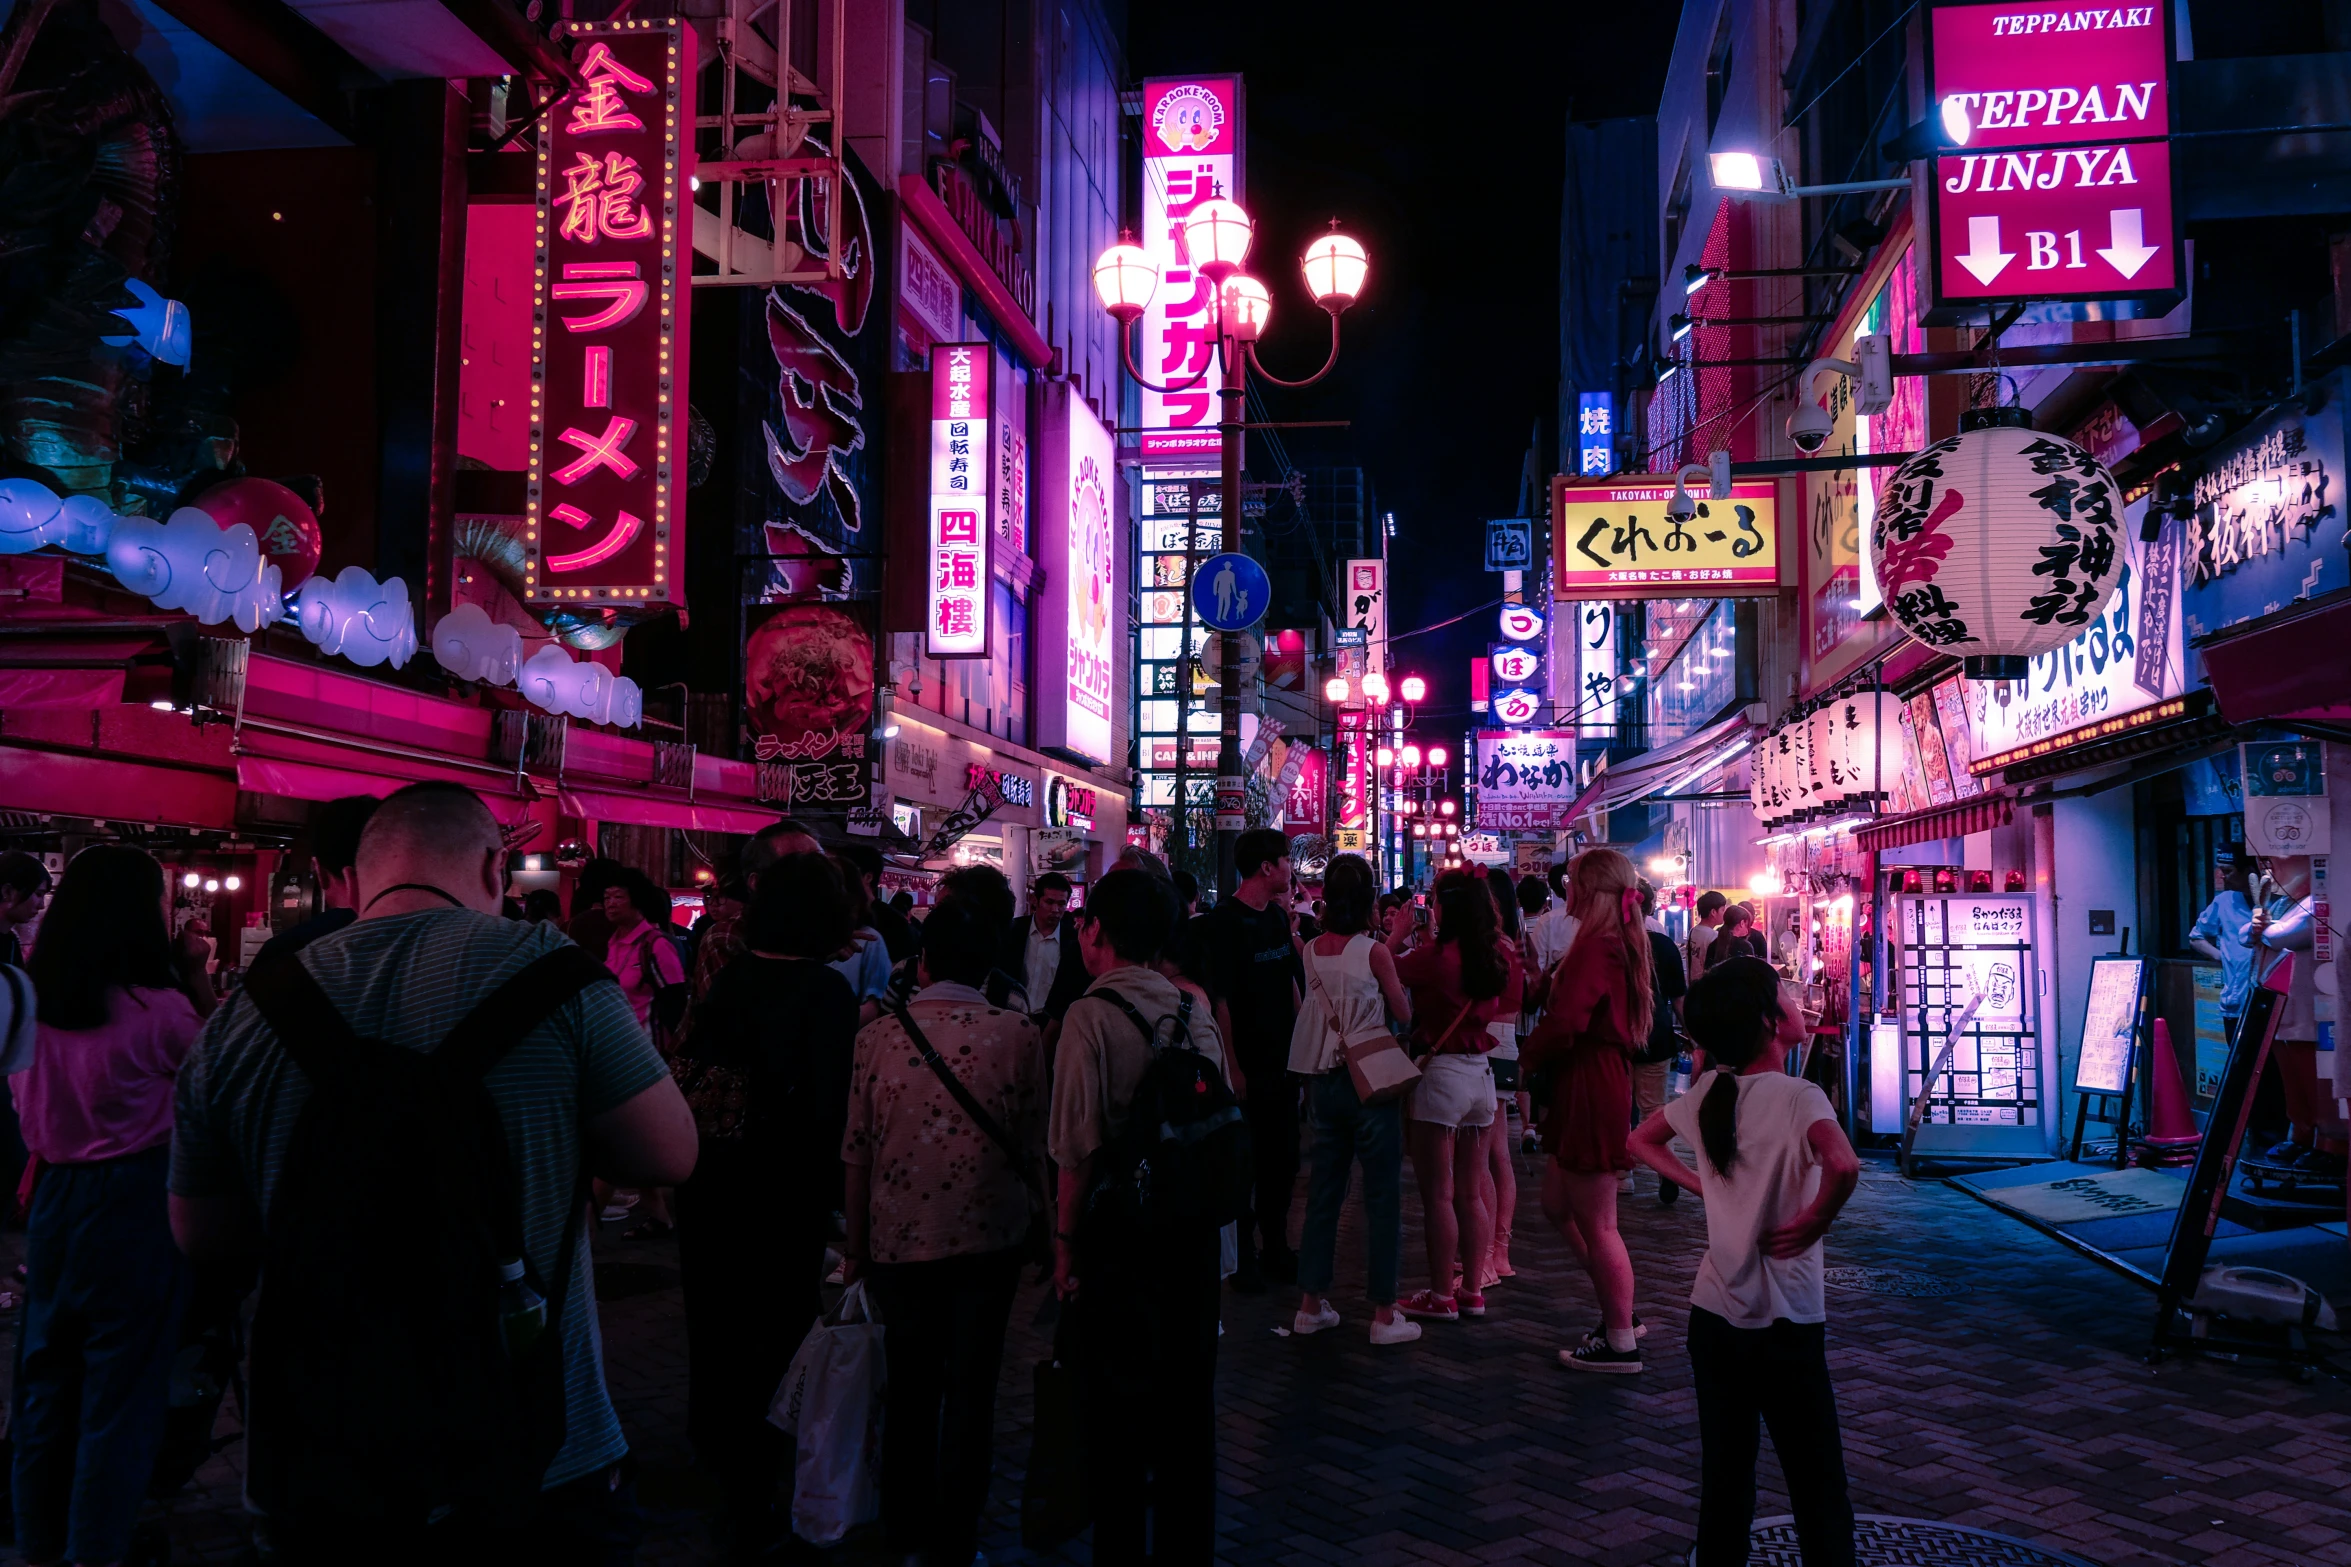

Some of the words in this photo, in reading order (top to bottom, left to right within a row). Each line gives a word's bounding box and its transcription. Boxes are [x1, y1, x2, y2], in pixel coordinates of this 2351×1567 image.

[1992, 7, 2153, 36] TEPPANYAKI
[1945, 82, 2157, 130] TEPPAN
[1945, 146, 2138, 194] JINJYA
[2026, 230, 2088, 271] B1
[546, 42, 658, 573] 金龍ラーメン
[949, 348, 971, 418] 大起水産
[949, 421, 970, 491] 回転寿司
[1580, 407, 1612, 473] 焼肉
[261, 515, 307, 555] 金
[2017, 437, 2118, 626] 鉄板神社
[936, 508, 980, 638] 四海樓
[1608, 572, 1647, 581] 大阪名物
[1649, 569, 1733, 580] たこ焼・お好み焼
[1502, 616, 1538, 717] づぼら
[755, 726, 838, 761] ラーメン
[1481, 754, 1573, 791] わなか
[1343, 832, 1357, 847] 薬
[1498, 812, 1533, 828] No.1
